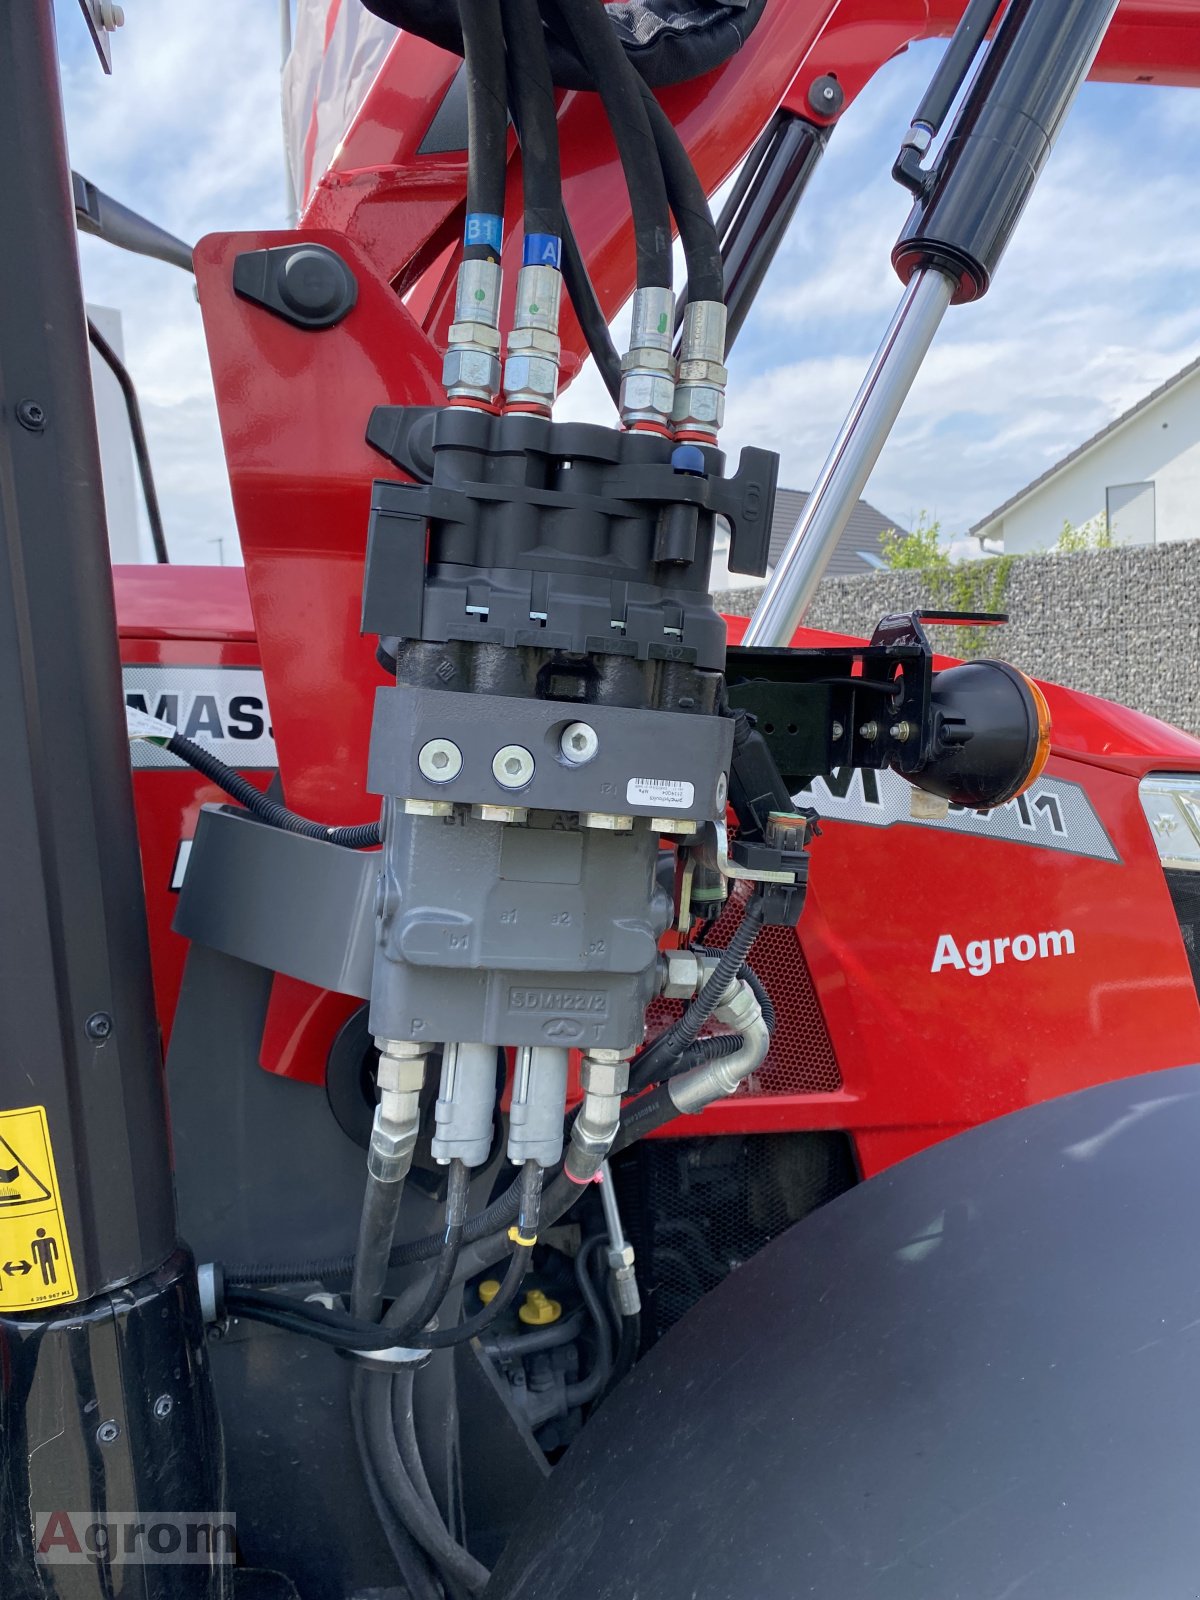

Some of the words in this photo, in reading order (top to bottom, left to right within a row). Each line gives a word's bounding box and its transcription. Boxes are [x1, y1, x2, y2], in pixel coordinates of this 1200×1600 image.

[468, 219, 493, 239] B1
[125, 693, 275, 740] MAS
[930, 928, 1075, 976] Agrom
[411, 1018, 425, 1036] P
[592, 1023, 606, 1041] T
